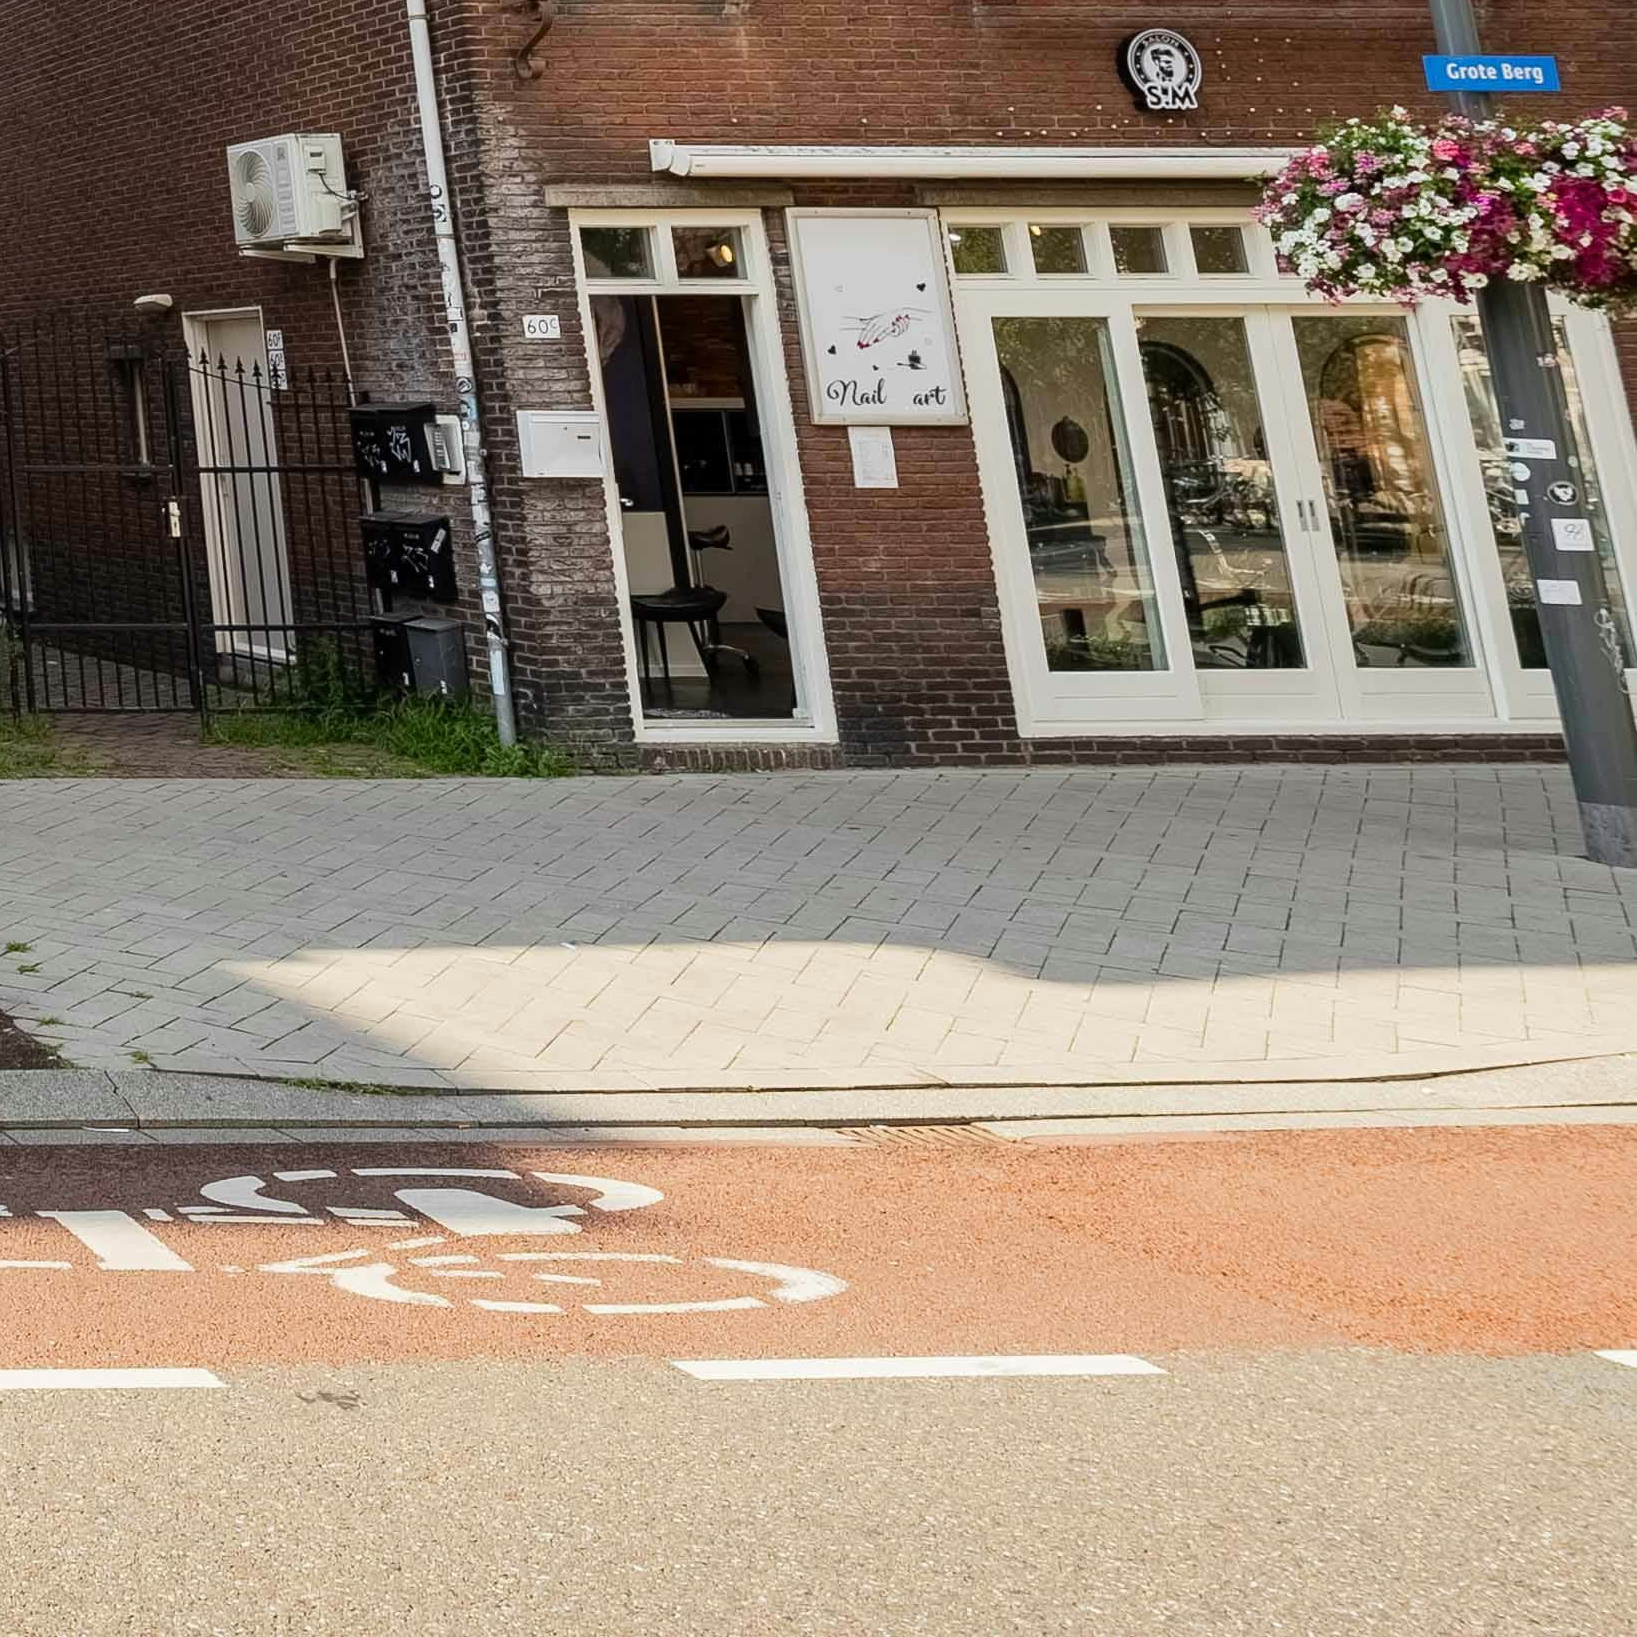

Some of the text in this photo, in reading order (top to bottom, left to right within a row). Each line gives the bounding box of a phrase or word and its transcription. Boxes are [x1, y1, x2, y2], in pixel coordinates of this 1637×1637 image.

[1446, 62, 1545, 85] Grote Berg
[527, 317, 558, 334] 60C
[826, 378, 947, 406] Nail art
